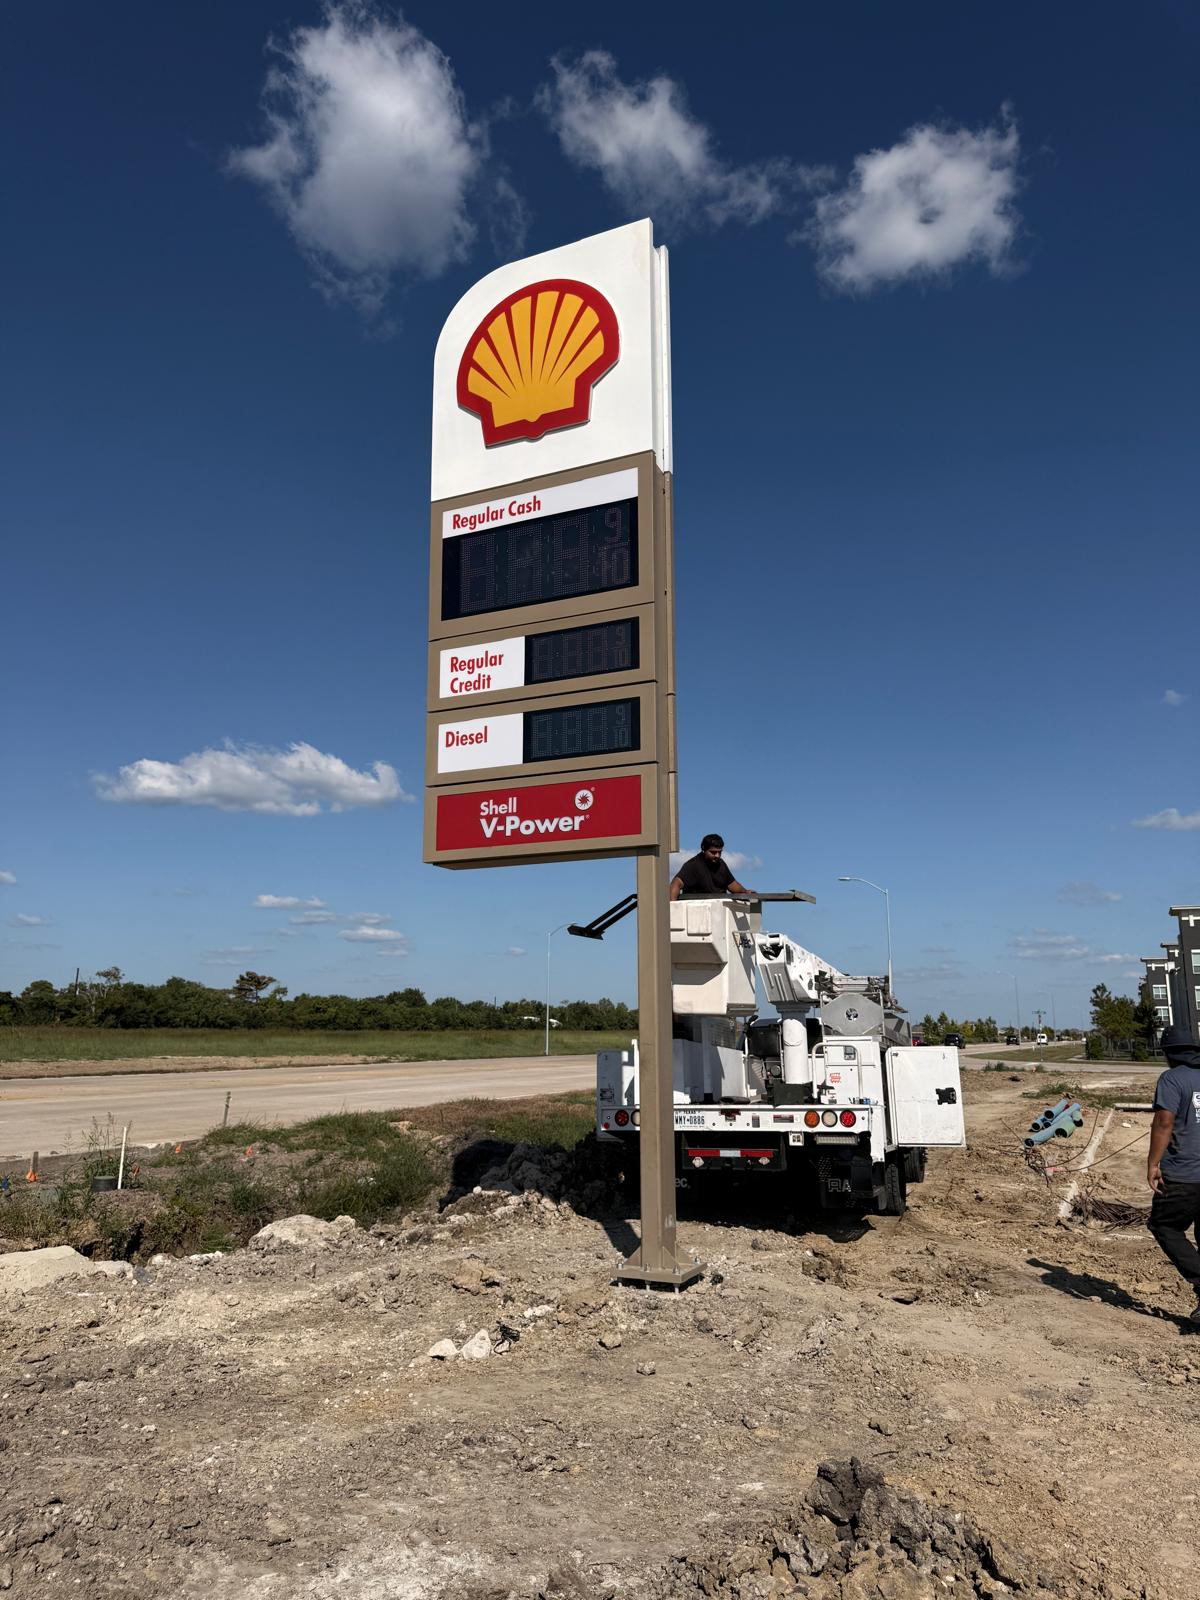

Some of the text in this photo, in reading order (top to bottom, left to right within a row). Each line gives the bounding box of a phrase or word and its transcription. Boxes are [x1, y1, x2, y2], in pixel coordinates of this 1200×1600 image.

[452, 495, 542, 531] Regular Cash
[450, 650, 504, 675] Regular
[449, 674, 492, 694] Credit
[445, 725, 488, 748] Diesel
[480, 797, 517, 816] Shell
[828, 1178, 852, 1193] RA
